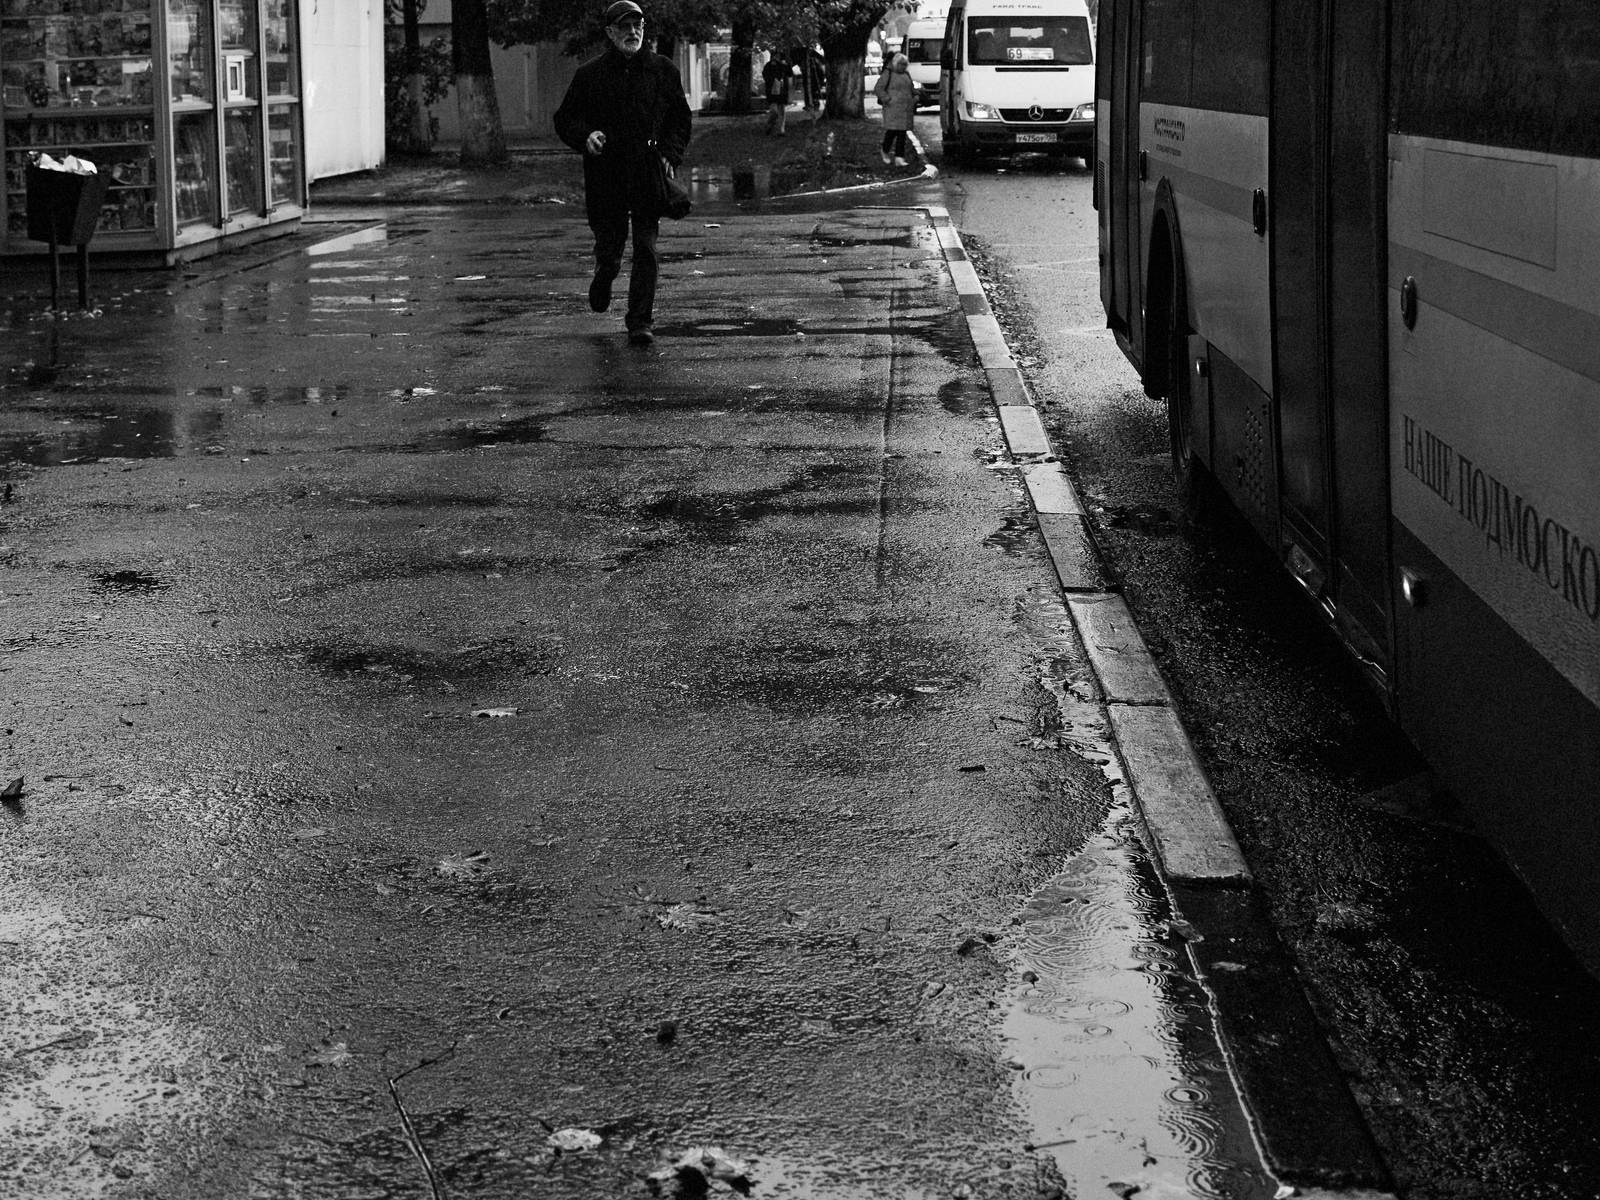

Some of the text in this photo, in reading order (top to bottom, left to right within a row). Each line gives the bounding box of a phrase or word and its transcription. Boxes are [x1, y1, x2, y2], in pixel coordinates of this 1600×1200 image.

[1008, 48, 1023, 60] 69
[1403, 414, 1600, 622] НАШЕ ПОДМОСКО
